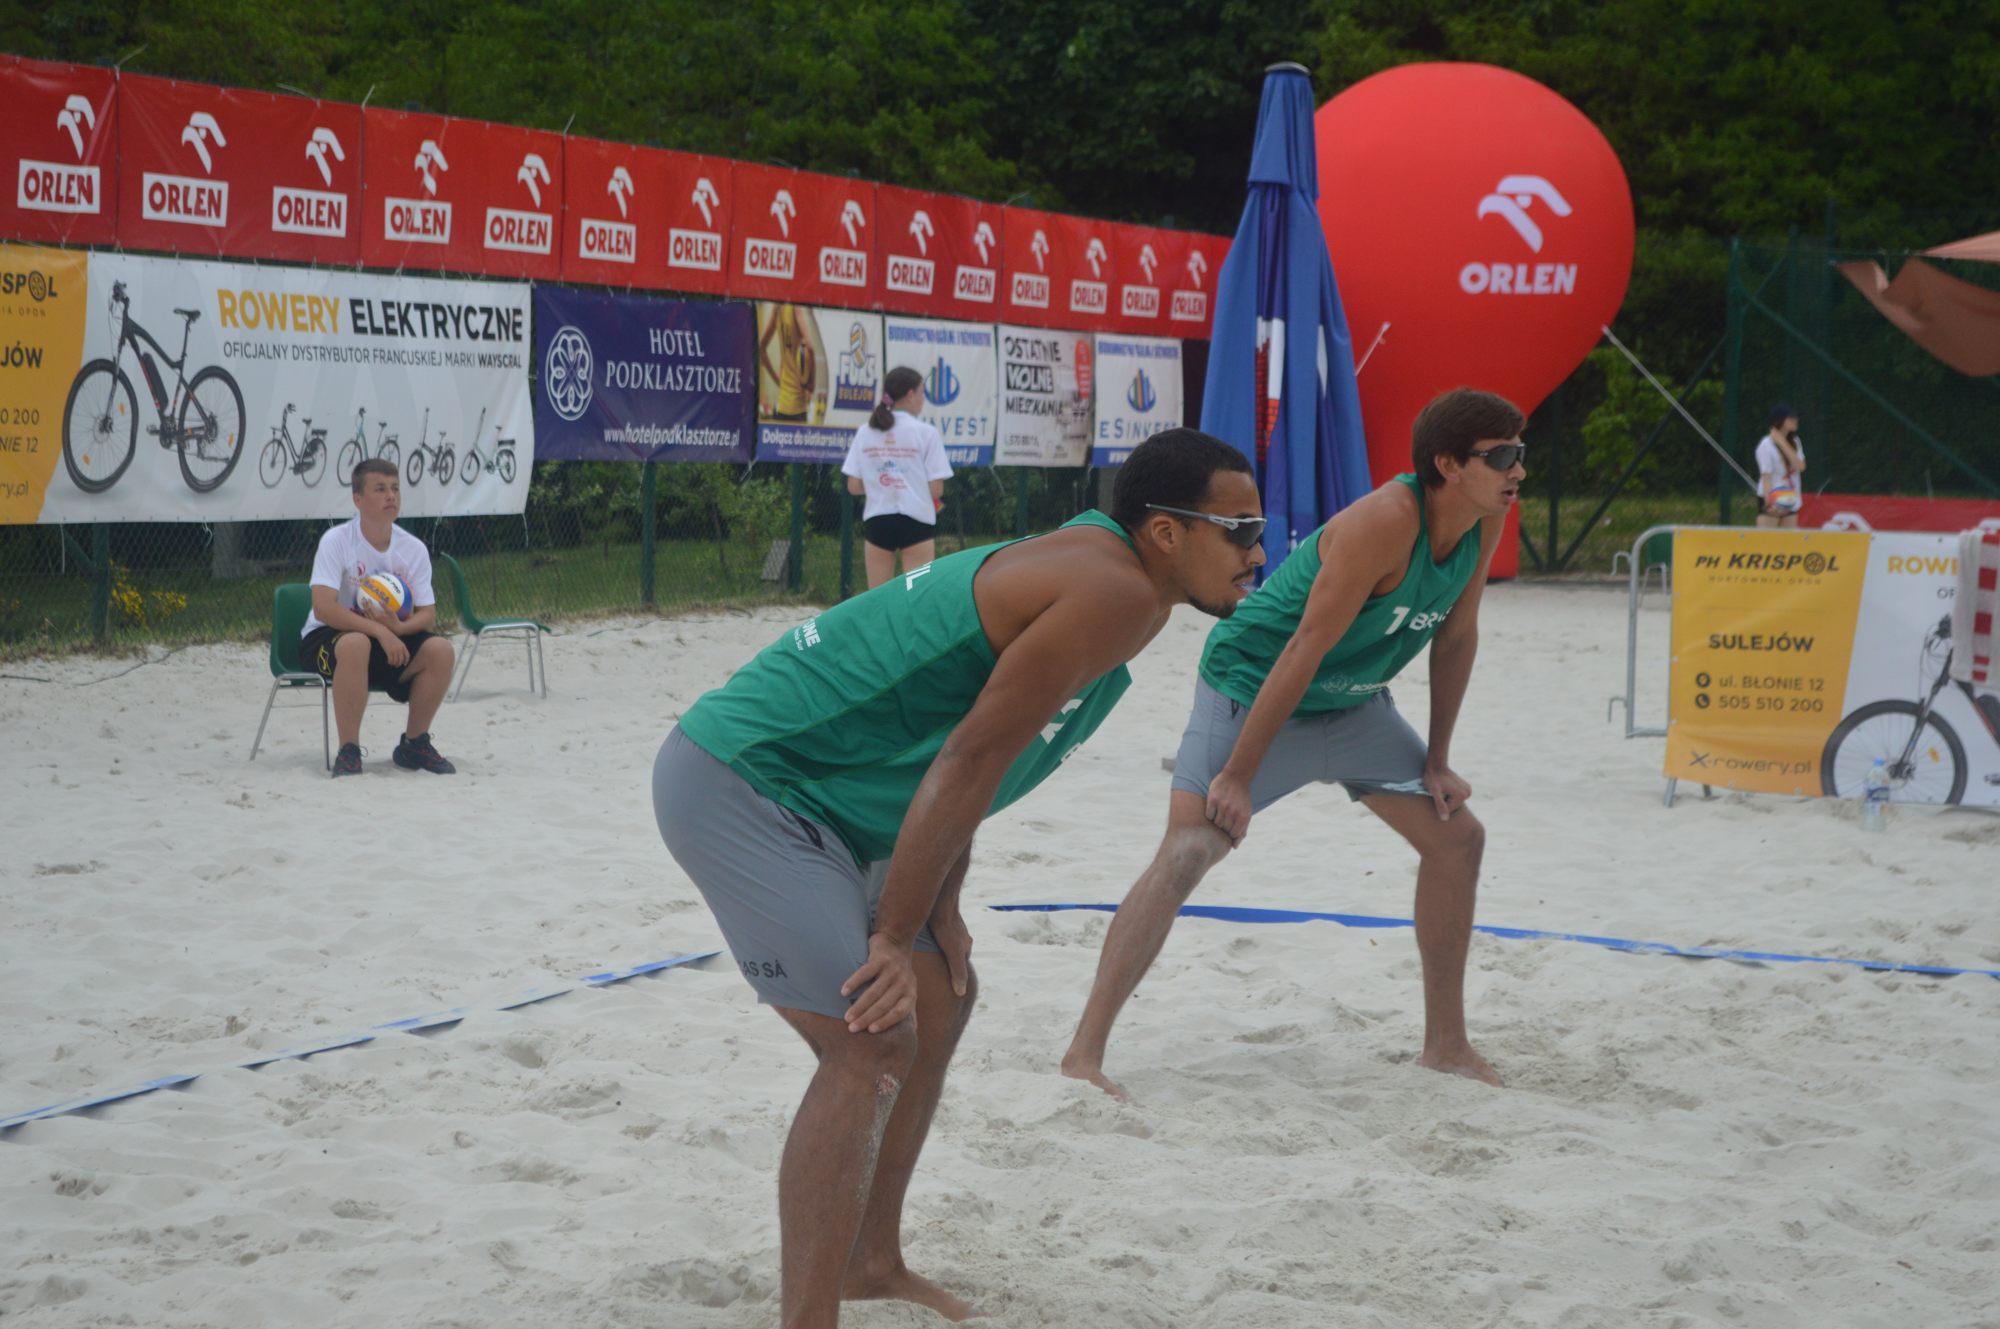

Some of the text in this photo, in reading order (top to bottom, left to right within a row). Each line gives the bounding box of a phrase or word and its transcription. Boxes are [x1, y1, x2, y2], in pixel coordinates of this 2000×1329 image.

[23, 168, 95, 207] ORLEN
[147, 180, 223, 220] ORLEN
[277, 194, 343, 230] ORLEN
[390, 204, 447, 238] ORLEN
[489, 214, 548, 248] ORLEN
[584, 225, 633, 257] ORLEN
[672, 235, 718, 264] ORLEN
[748, 245, 792, 273] ORLEN
[824, 258, 864, 281] ORLEN
[891, 262, 931, 288] ORLEN
[1459, 262, 1578, 295] ORLEN
[0, 270, 58, 302] SPOL
[958, 272, 992, 297] ORLEN
[1015, 279, 1048, 302] ORLEN
[1074, 285, 1105, 308] ORLEN
[217, 288, 523, 342] ROWERY ELEKTRYCZNE
[1125, 291, 1157, 313] ORLEN
[1174, 297, 1205, 316] ORLEN
[223, 341, 522, 369] OFICJALNY DYSTRYBUTOR FRANCUSKIEJ MARKI WAYSCRAL
[649, 328, 705, 358] HOTEL
[1005, 336, 1062, 362] OSTATNIE
[605, 360, 742, 394] PODKLASZTORZE
[13, 408, 40, 426] 200
[27, 436, 39, 454] 12
[1695, 551, 1840, 576] PH KRISPOL
[1384, 606, 1411, 635] 1
[1708, 631, 1815, 653] SULEJÓW
[1718, 674, 1825, 692] ul. BŁONIE 12
[1718, 695, 1824, 713] 505 510 200
